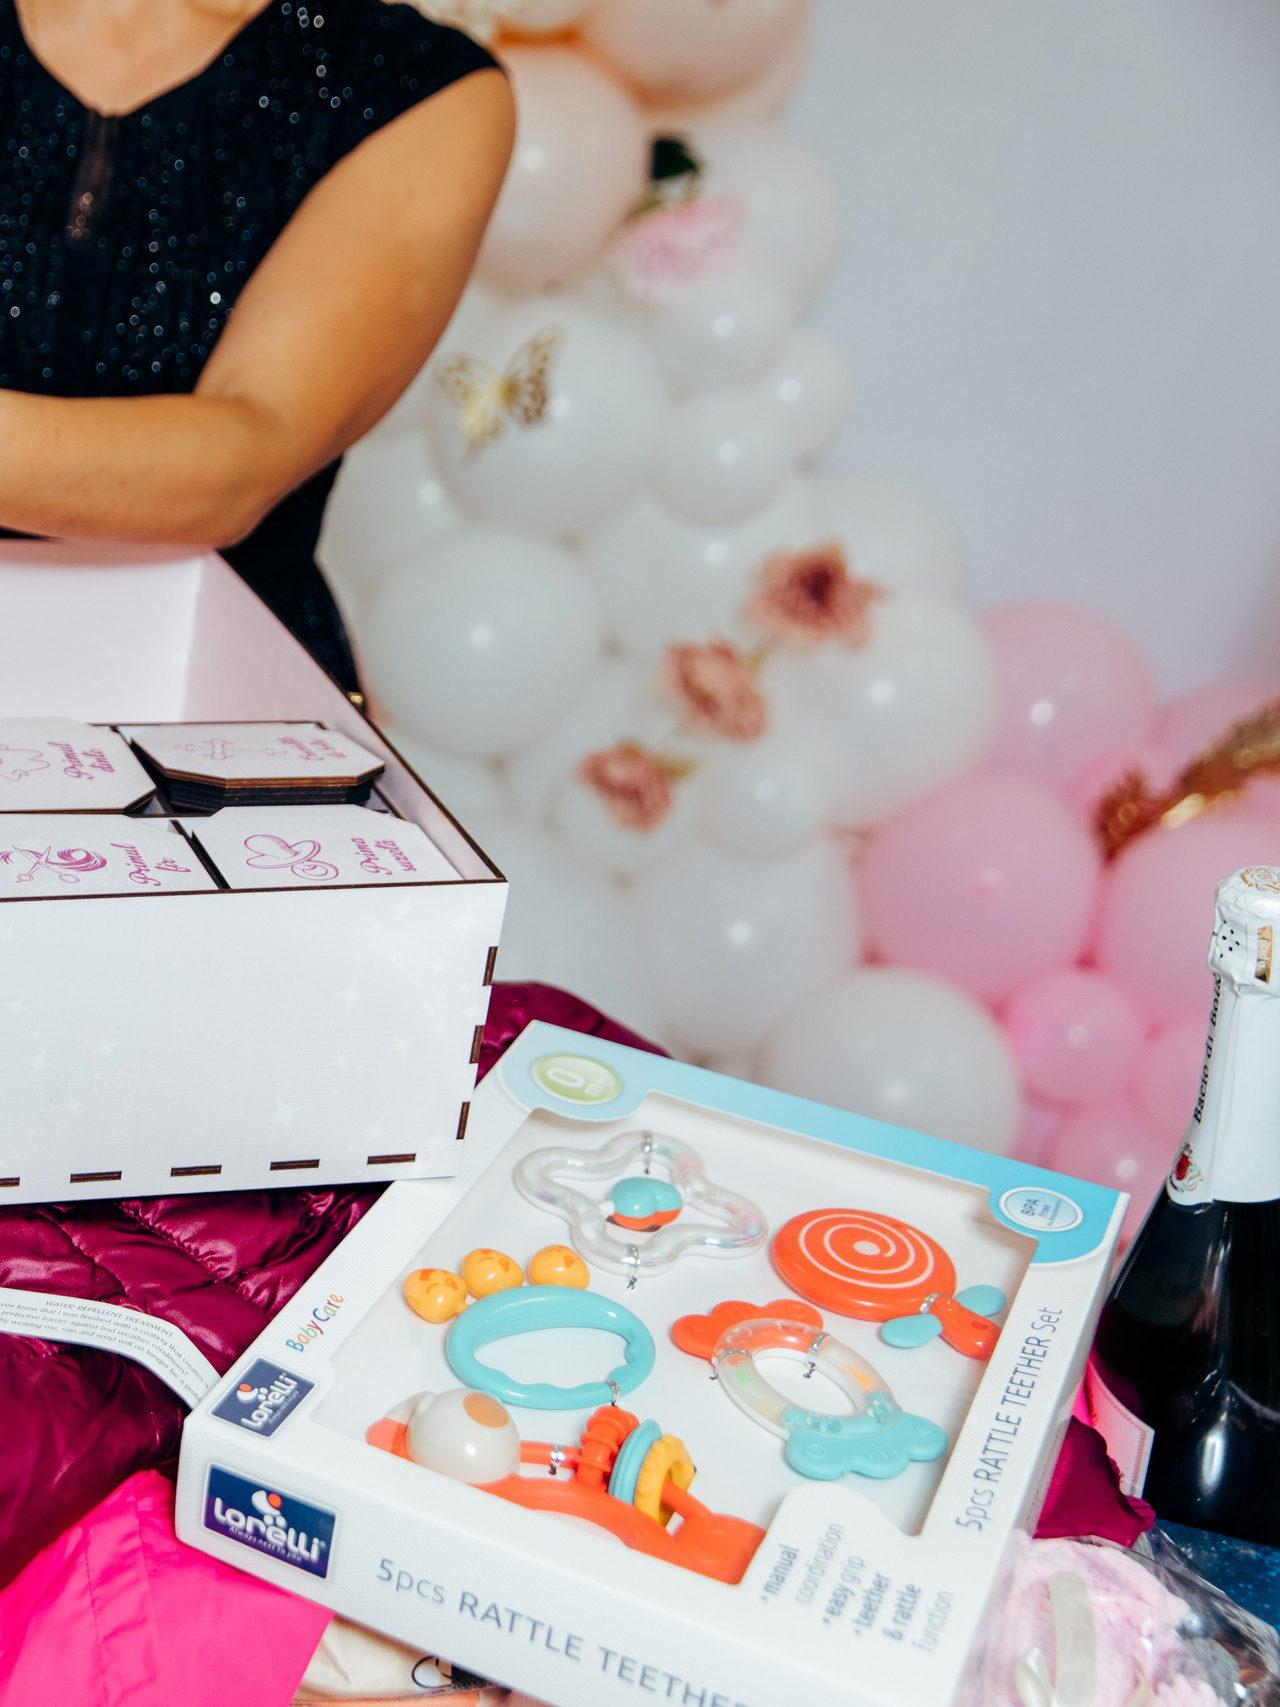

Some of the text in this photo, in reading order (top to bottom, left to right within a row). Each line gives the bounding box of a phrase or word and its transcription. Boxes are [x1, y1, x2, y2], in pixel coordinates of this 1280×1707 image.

[46, 741, 94, 779] Primul
[109, 842, 162, 887] Primul
[154, 856, 192, 872] fir
[351, 836, 393, 875] Prima
[1021, 1199, 1039, 1216] BPA
[1, 1310, 189, 1377] protective barrier against bad weather conditions?
[17, 1303, 38, 1313] know
[80, 1313, 112, 1325] finished
[113, 1321, 131, 1330] with
[140, 1328, 168, 1346] coating
[169, 1344, 182, 1359] that
[182, 1358, 204, 1382] creates
[45, 1301, 173, 1338] WATER-REPELLENT TREATMENT
[10, 1320, 42, 1329] wearing
[78, 1329, 95, 1337] and
[96, 1332, 116, 1341] wind
[118, 1338, 133, 1347] will
[146, 1349, 169, 1369] longer
[169, 1368, 179, 1378] be
[240, 1374, 298, 1428] Lorelli
[955, 1306, 1063, 1531] 5pcs RATTLE TEETHER Set
[213, 1496, 321, 1561] Lorelli
[228, 1525, 302, 1561] Always next to you
[763, 1543, 799, 1596] manual
[795, 1523, 846, 1605] coordination
[825, 1555, 868, 1617] easy grip
[852, 1571, 891, 1628] teether
[882, 1583, 922, 1642] & rattle
[912, 1590, 955, 1652] function
[376, 1557, 749, 1707] 5pcs RATTLE TEETHE
